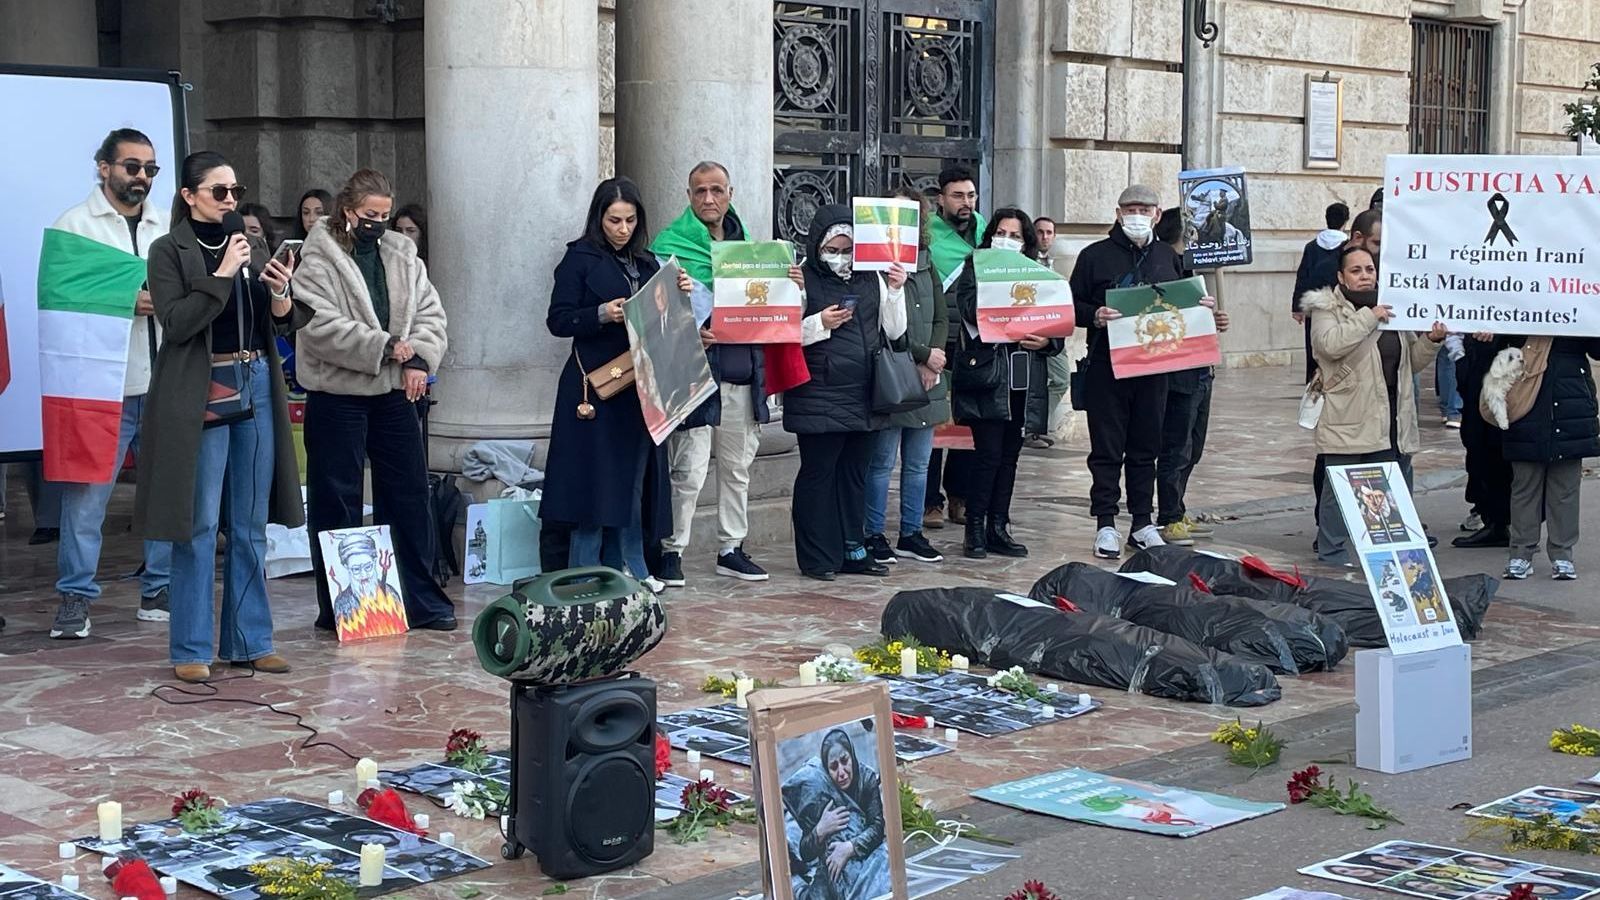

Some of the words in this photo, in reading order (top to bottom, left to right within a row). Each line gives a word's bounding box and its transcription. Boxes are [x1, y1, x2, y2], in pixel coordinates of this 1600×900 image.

[1393, 176, 1400, 197] ¡
[1409, 171, 1544, 193] JUSTICIA
[1553, 173, 1600, 194] YA
[1184, 240, 1199, 250] شاد
[1200, 241, 1222, 250] روحت
[1193, 256, 1218, 264] Pahlavi
[1407, 244, 1427, 260] El
[1450, 244, 1528, 265] régimen
[1535, 246, 1585, 264] Iraní
[1389, 272, 1429, 290] Está
[1436, 273, 1523, 293] Matando
[1529, 279, 1540, 293] a
[1547, 276, 1600, 295] Miles
[773, 313, 789, 322] IRÁN
[1046, 312, 1061, 320] IRÁN
[1406, 302, 1428, 319] de
[1435, 303, 1578, 324] Manifestantes!
[1389, 626, 1430, 644] Holocaust
